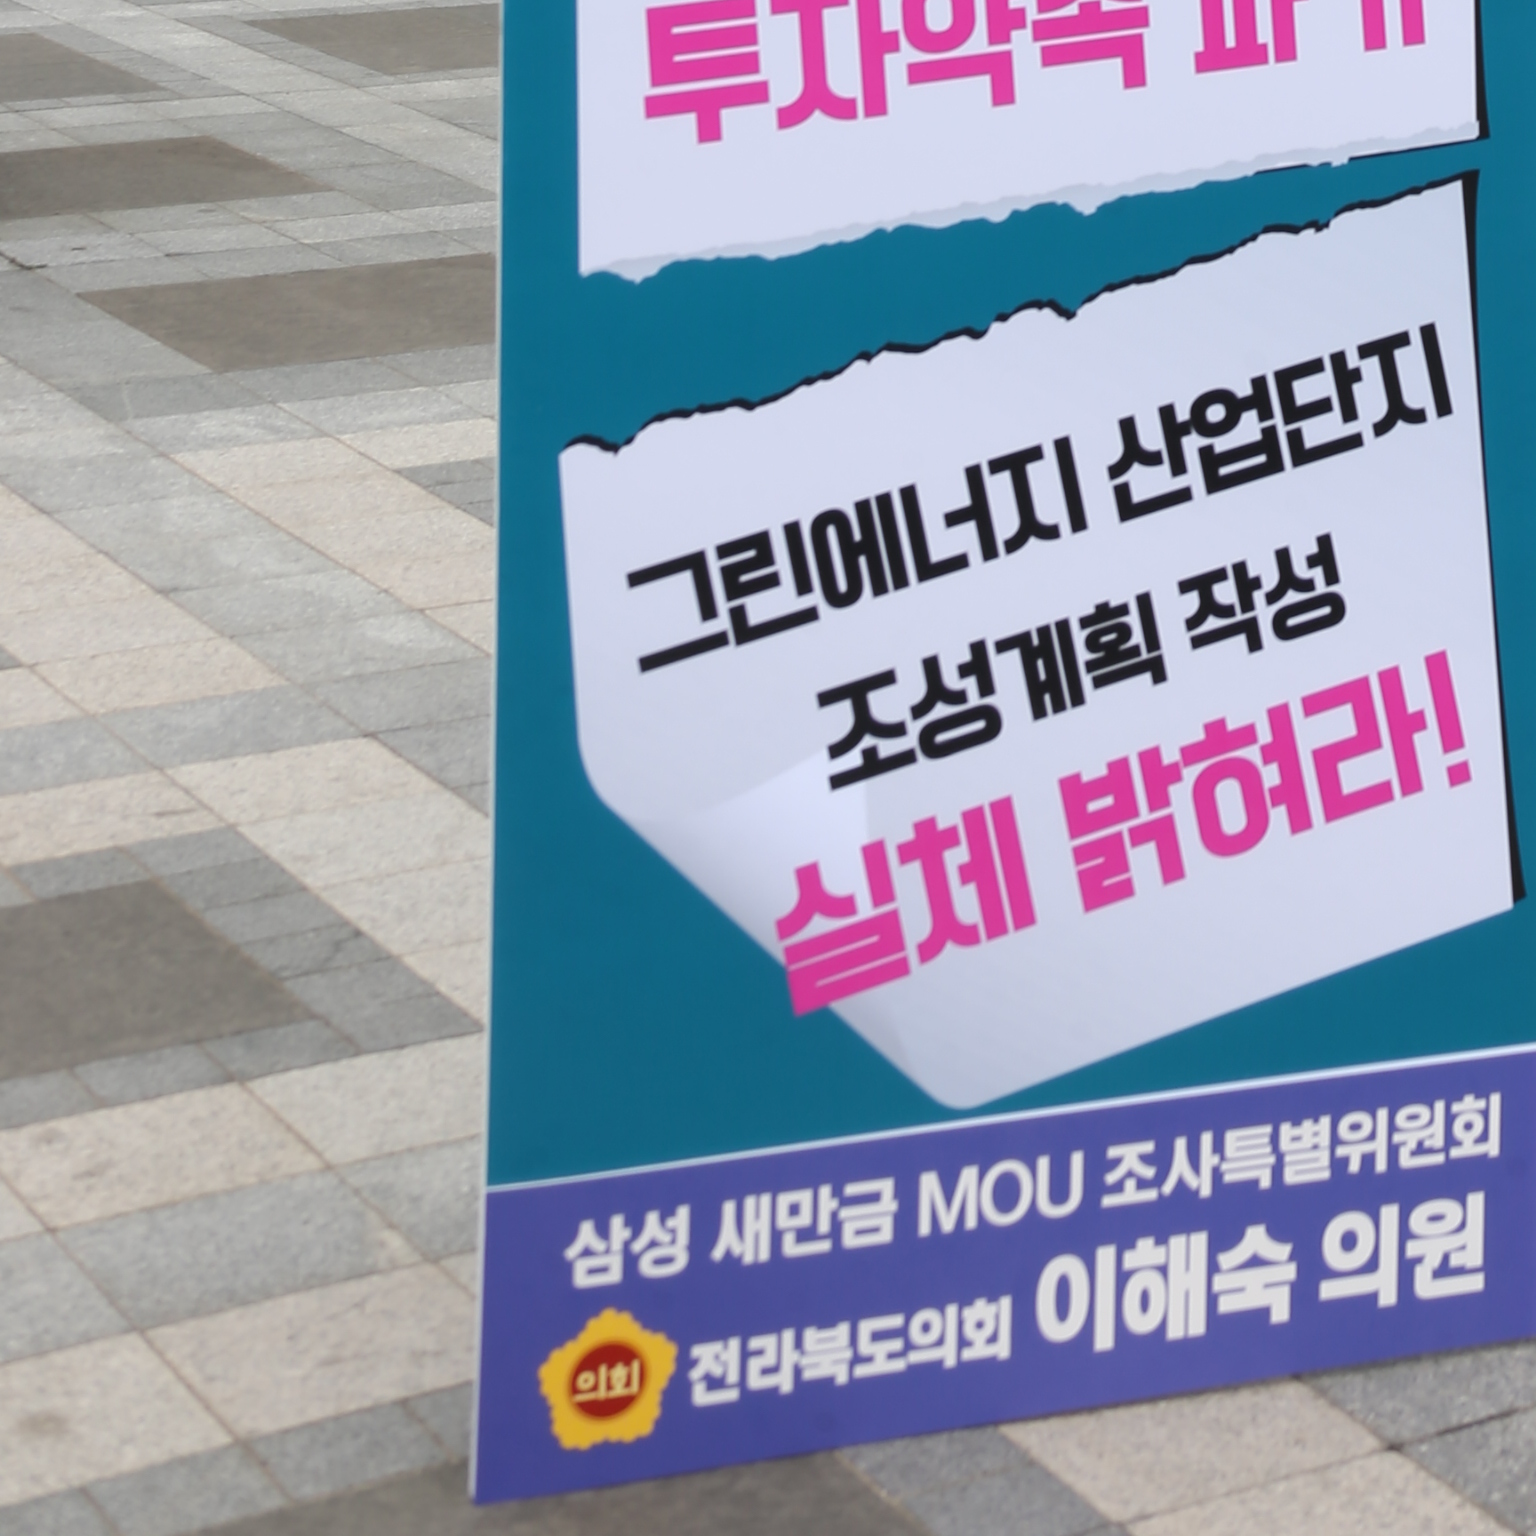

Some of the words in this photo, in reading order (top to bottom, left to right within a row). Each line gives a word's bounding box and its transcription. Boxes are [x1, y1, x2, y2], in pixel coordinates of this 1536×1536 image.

[625, 435, 1089, 674] 그린에너지
[1107, 321, 1456, 523] 산업단지
[816, 591, 1168, 792] 조성계획
[1177, 532, 1347, 654] 작성
[775, 795, 1038, 1017] 실체
[1058, 649, 1474, 913] 밝혀라!
[564, 1204, 692, 1290] 삼성
[710, 1176, 899, 1268] 새만금
[917, 1150, 1086, 1238] MOU
[1100, 1092, 1502, 1213] 조사특별위원회
[687, 1295, 1013, 1409] 전라북도의회
[1034, 1223, 1298, 1352] 이해숙
[1317, 1190, 1487, 1309] 의원
[573, 1358, 641, 1403] 의회
